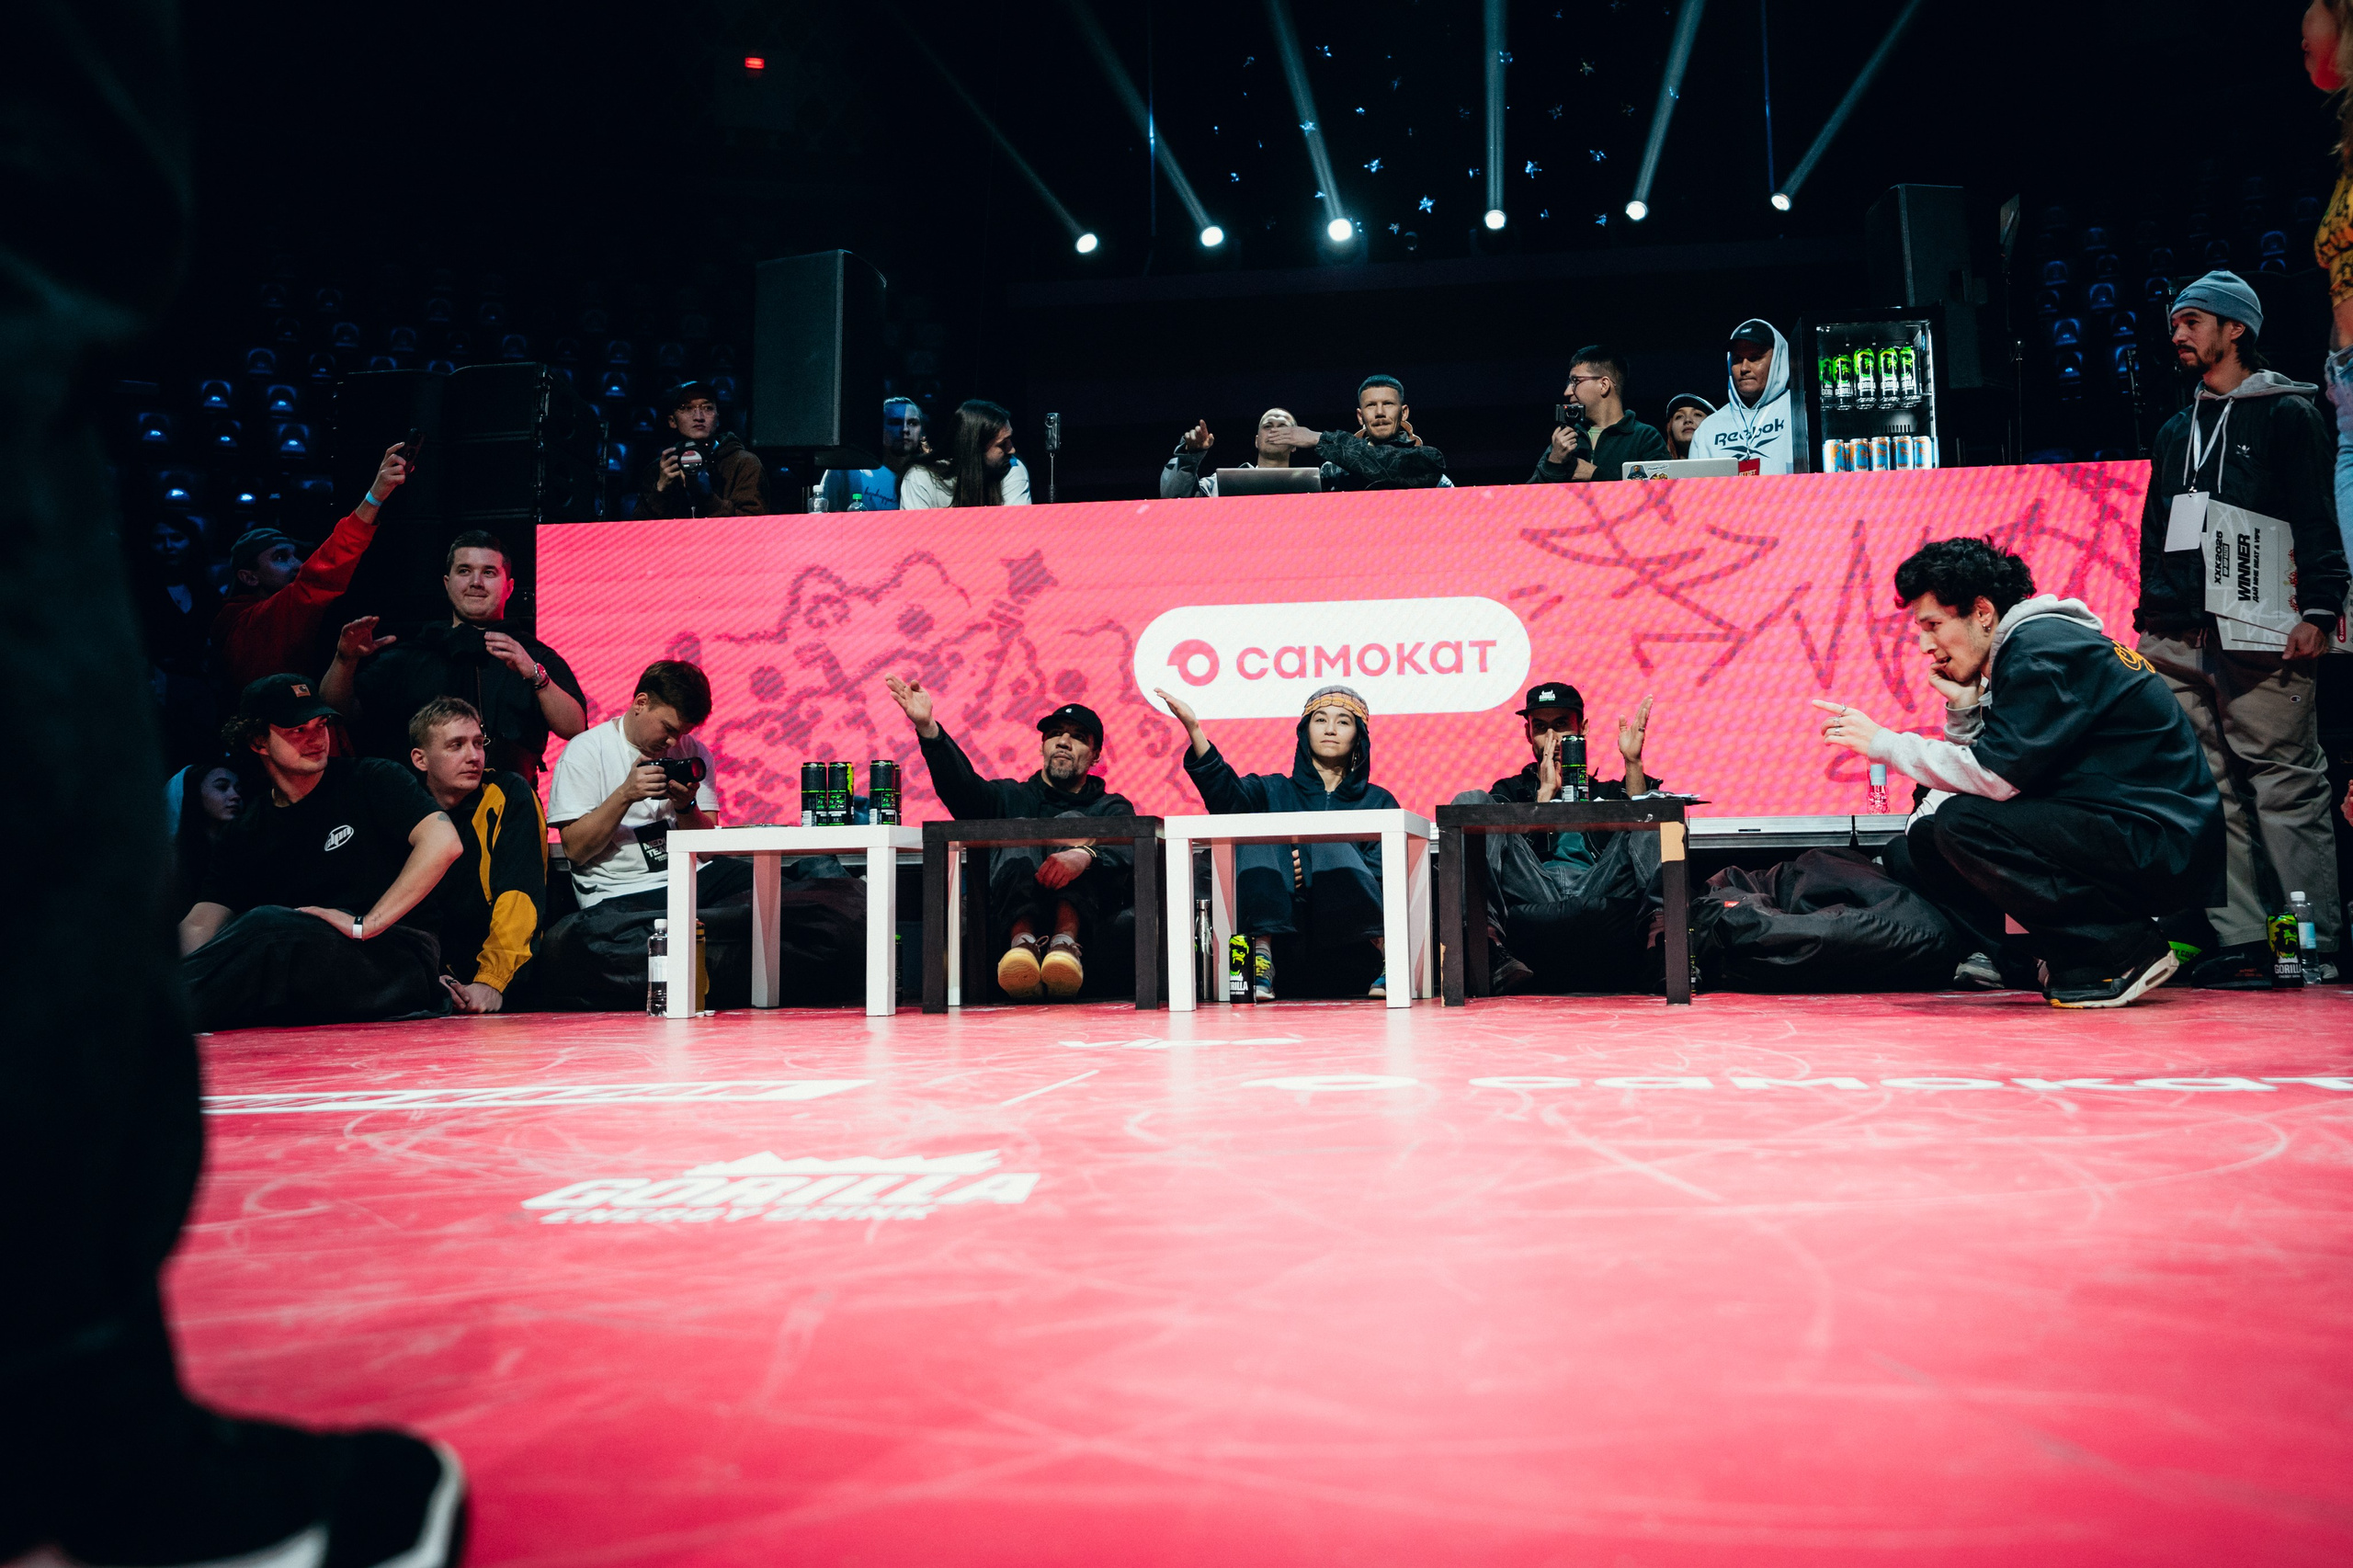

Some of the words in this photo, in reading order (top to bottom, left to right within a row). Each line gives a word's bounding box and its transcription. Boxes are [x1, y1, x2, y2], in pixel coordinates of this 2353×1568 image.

[1714, 418, 1785, 446] Reebok
[2214, 530, 2223, 585] XXK2025
[2237, 533, 2251, 602] WINNER
[1236, 640, 1497, 680] самокат
[642, 837, 666, 850] MEDI
[646, 846, 666, 858] TEA
[1230, 981, 1248, 991] RILLA
[521, 1172, 1041, 1210] GORILLA
[540, 1207, 764, 1225] ENERGY
[763, 1205, 938, 1222] DRINK
